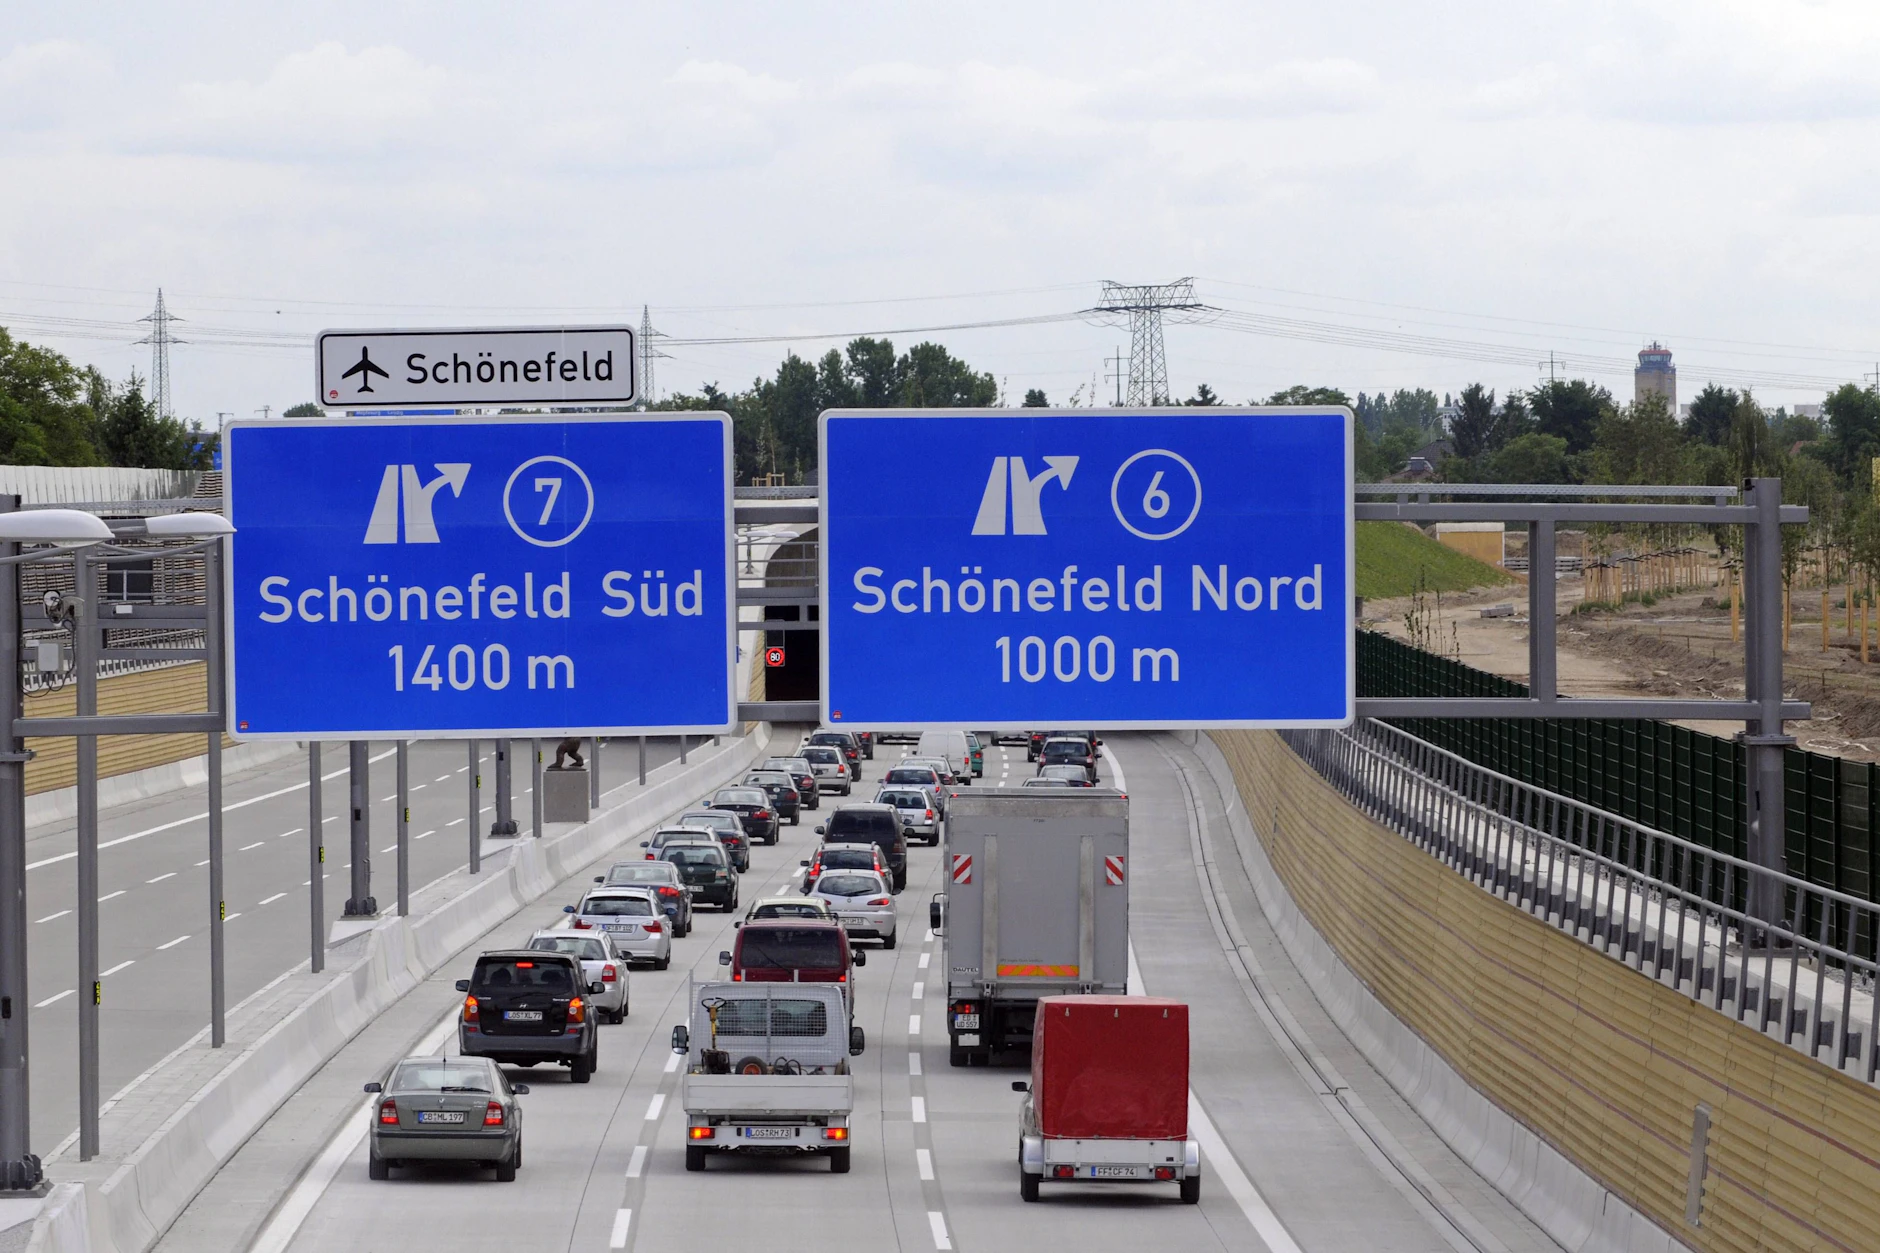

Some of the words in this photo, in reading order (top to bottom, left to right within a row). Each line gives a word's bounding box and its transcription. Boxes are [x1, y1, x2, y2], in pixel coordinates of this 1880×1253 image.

[406, 350, 613, 384] Schönefeld
[534, 477, 562, 526] 7
[1142, 470, 1170, 519] 6
[259, 571, 571, 624] Schönefeld
[601, 569, 703, 618] Süd
[852, 564, 1162, 614] Schönefeld
[1192, 563, 1323, 611] Nord
[388, 643, 511, 692] 1400
[527, 654, 575, 690] m
[995, 635, 1116, 683] 1000
[1132, 647, 1180, 682] m
[422, 1113, 433, 1121] CB
[437, 1113, 448, 1121] ML
[449, 1113, 463, 1121] 197
[751, 1129, 765, 1137] LOS
[769, 1129, 779, 1137] RH
[780, 1129, 790, 1137] 73
[1097, 1167, 1108, 1176] FF
[1125, 1167, 1134, 1176] 74
